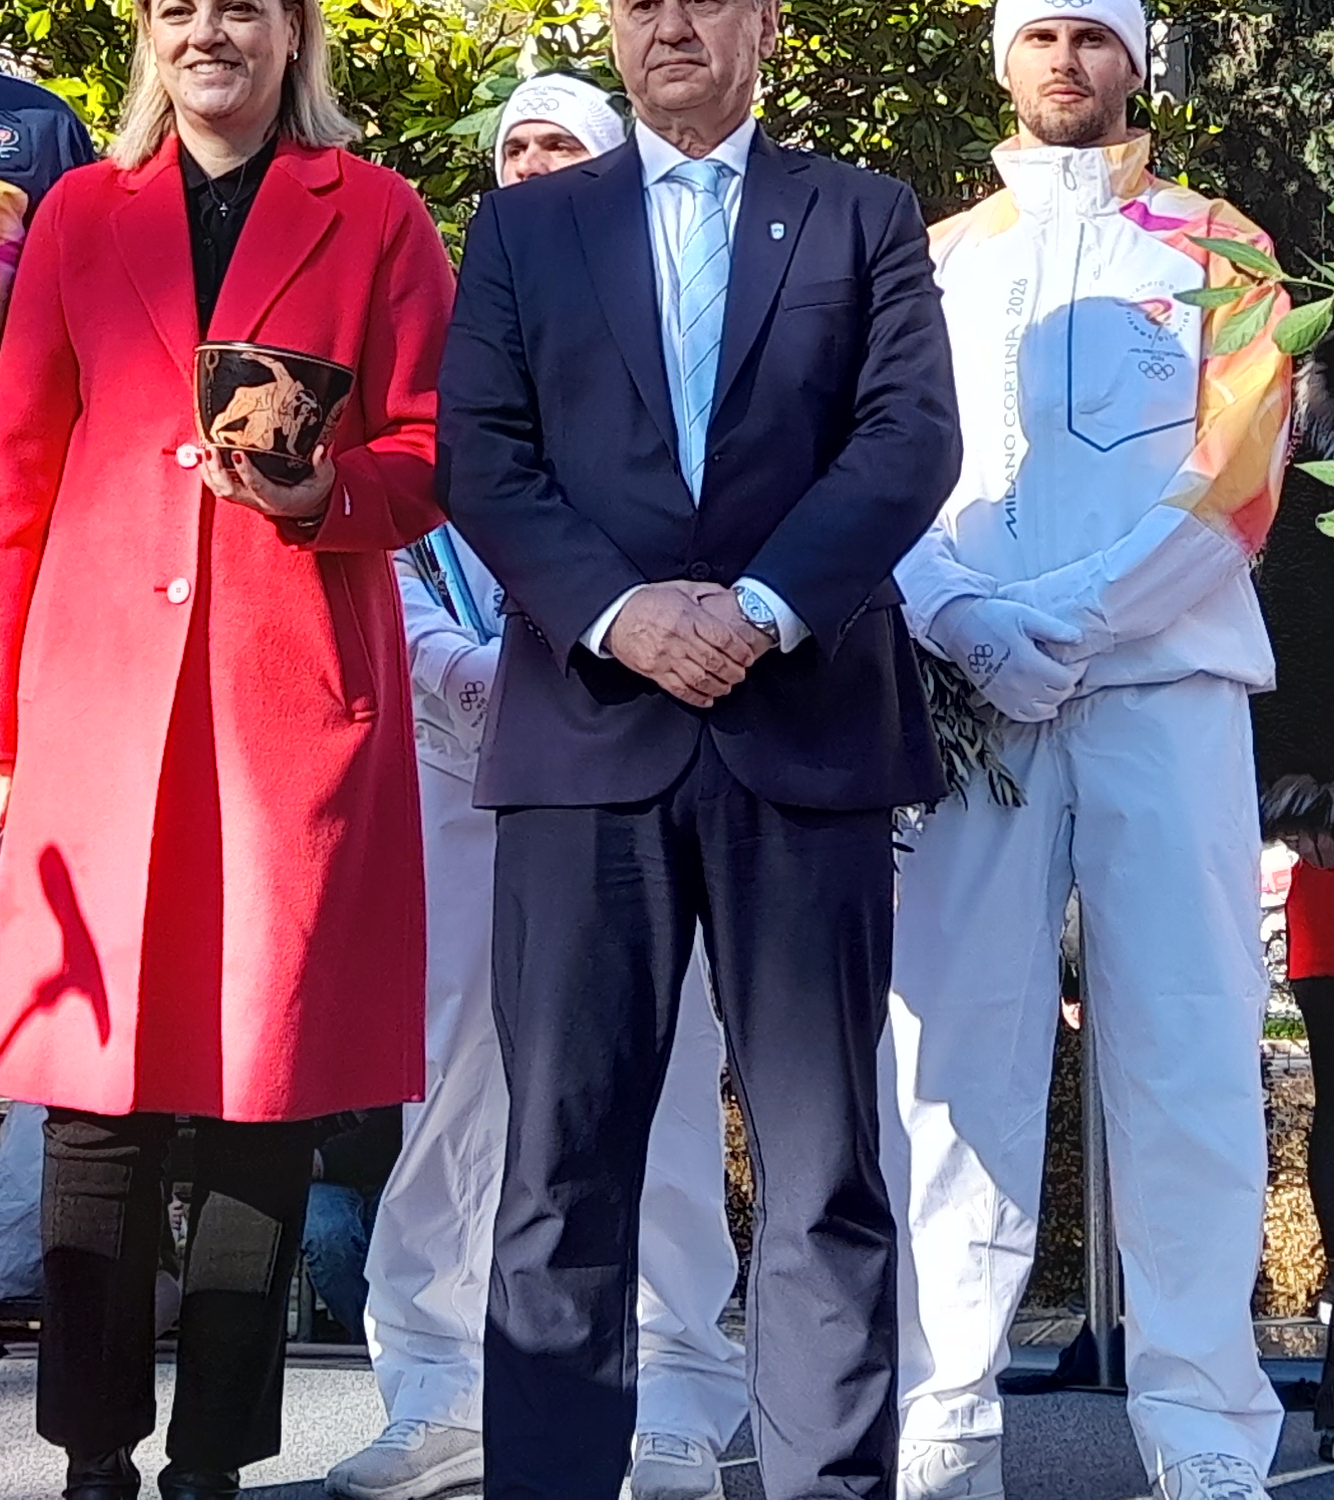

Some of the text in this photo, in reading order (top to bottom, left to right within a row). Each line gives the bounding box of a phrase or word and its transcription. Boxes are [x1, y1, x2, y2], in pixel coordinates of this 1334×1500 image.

[1004, 278, 1028, 540] MILANO CORTINA 2026
